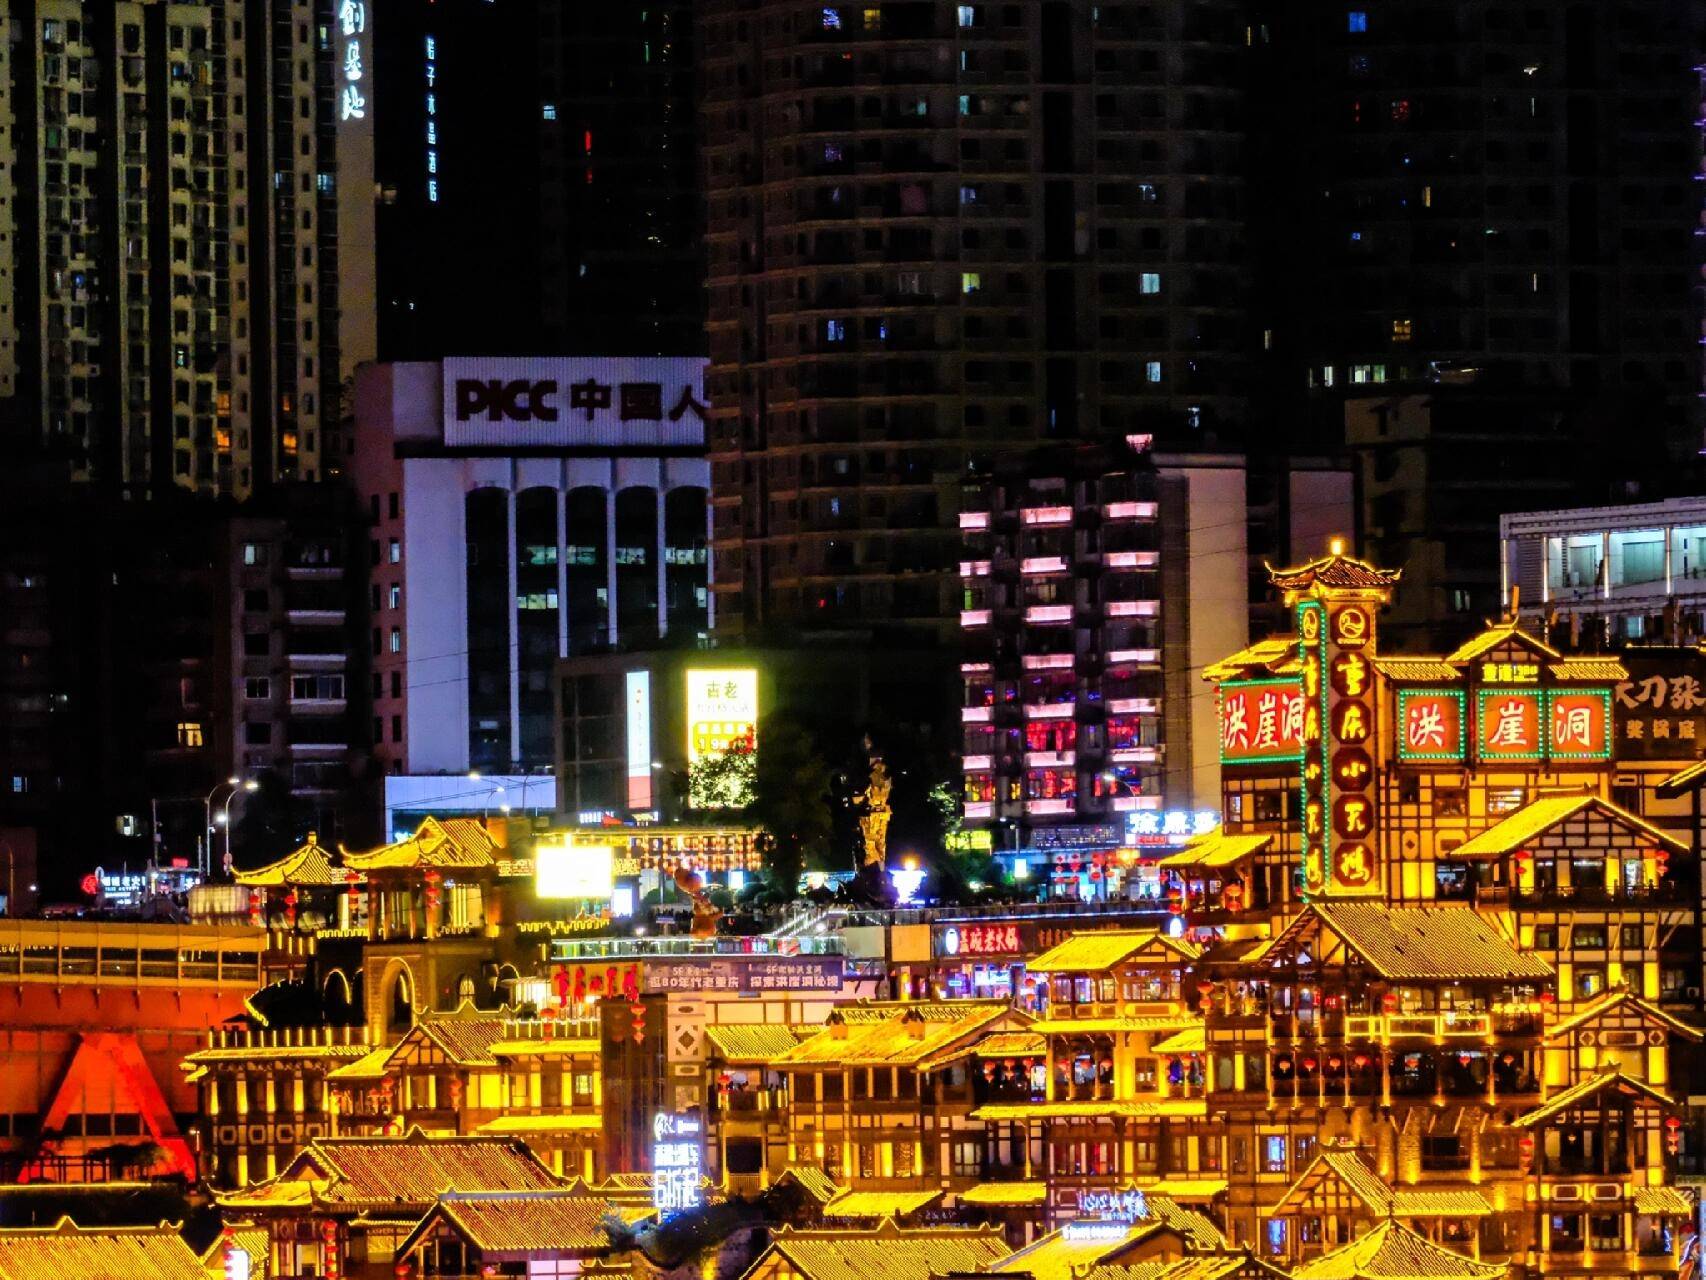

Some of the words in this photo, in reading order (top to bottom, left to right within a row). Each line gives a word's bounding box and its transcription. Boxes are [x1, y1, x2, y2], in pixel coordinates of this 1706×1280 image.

[456, 379, 557, 421] PICC
[1224, 691, 1304, 750] 洪崖洞
[1409, 701, 1592, 746] 洪崖洞
[1338, 653, 1369, 882] 重庆小天鹅
